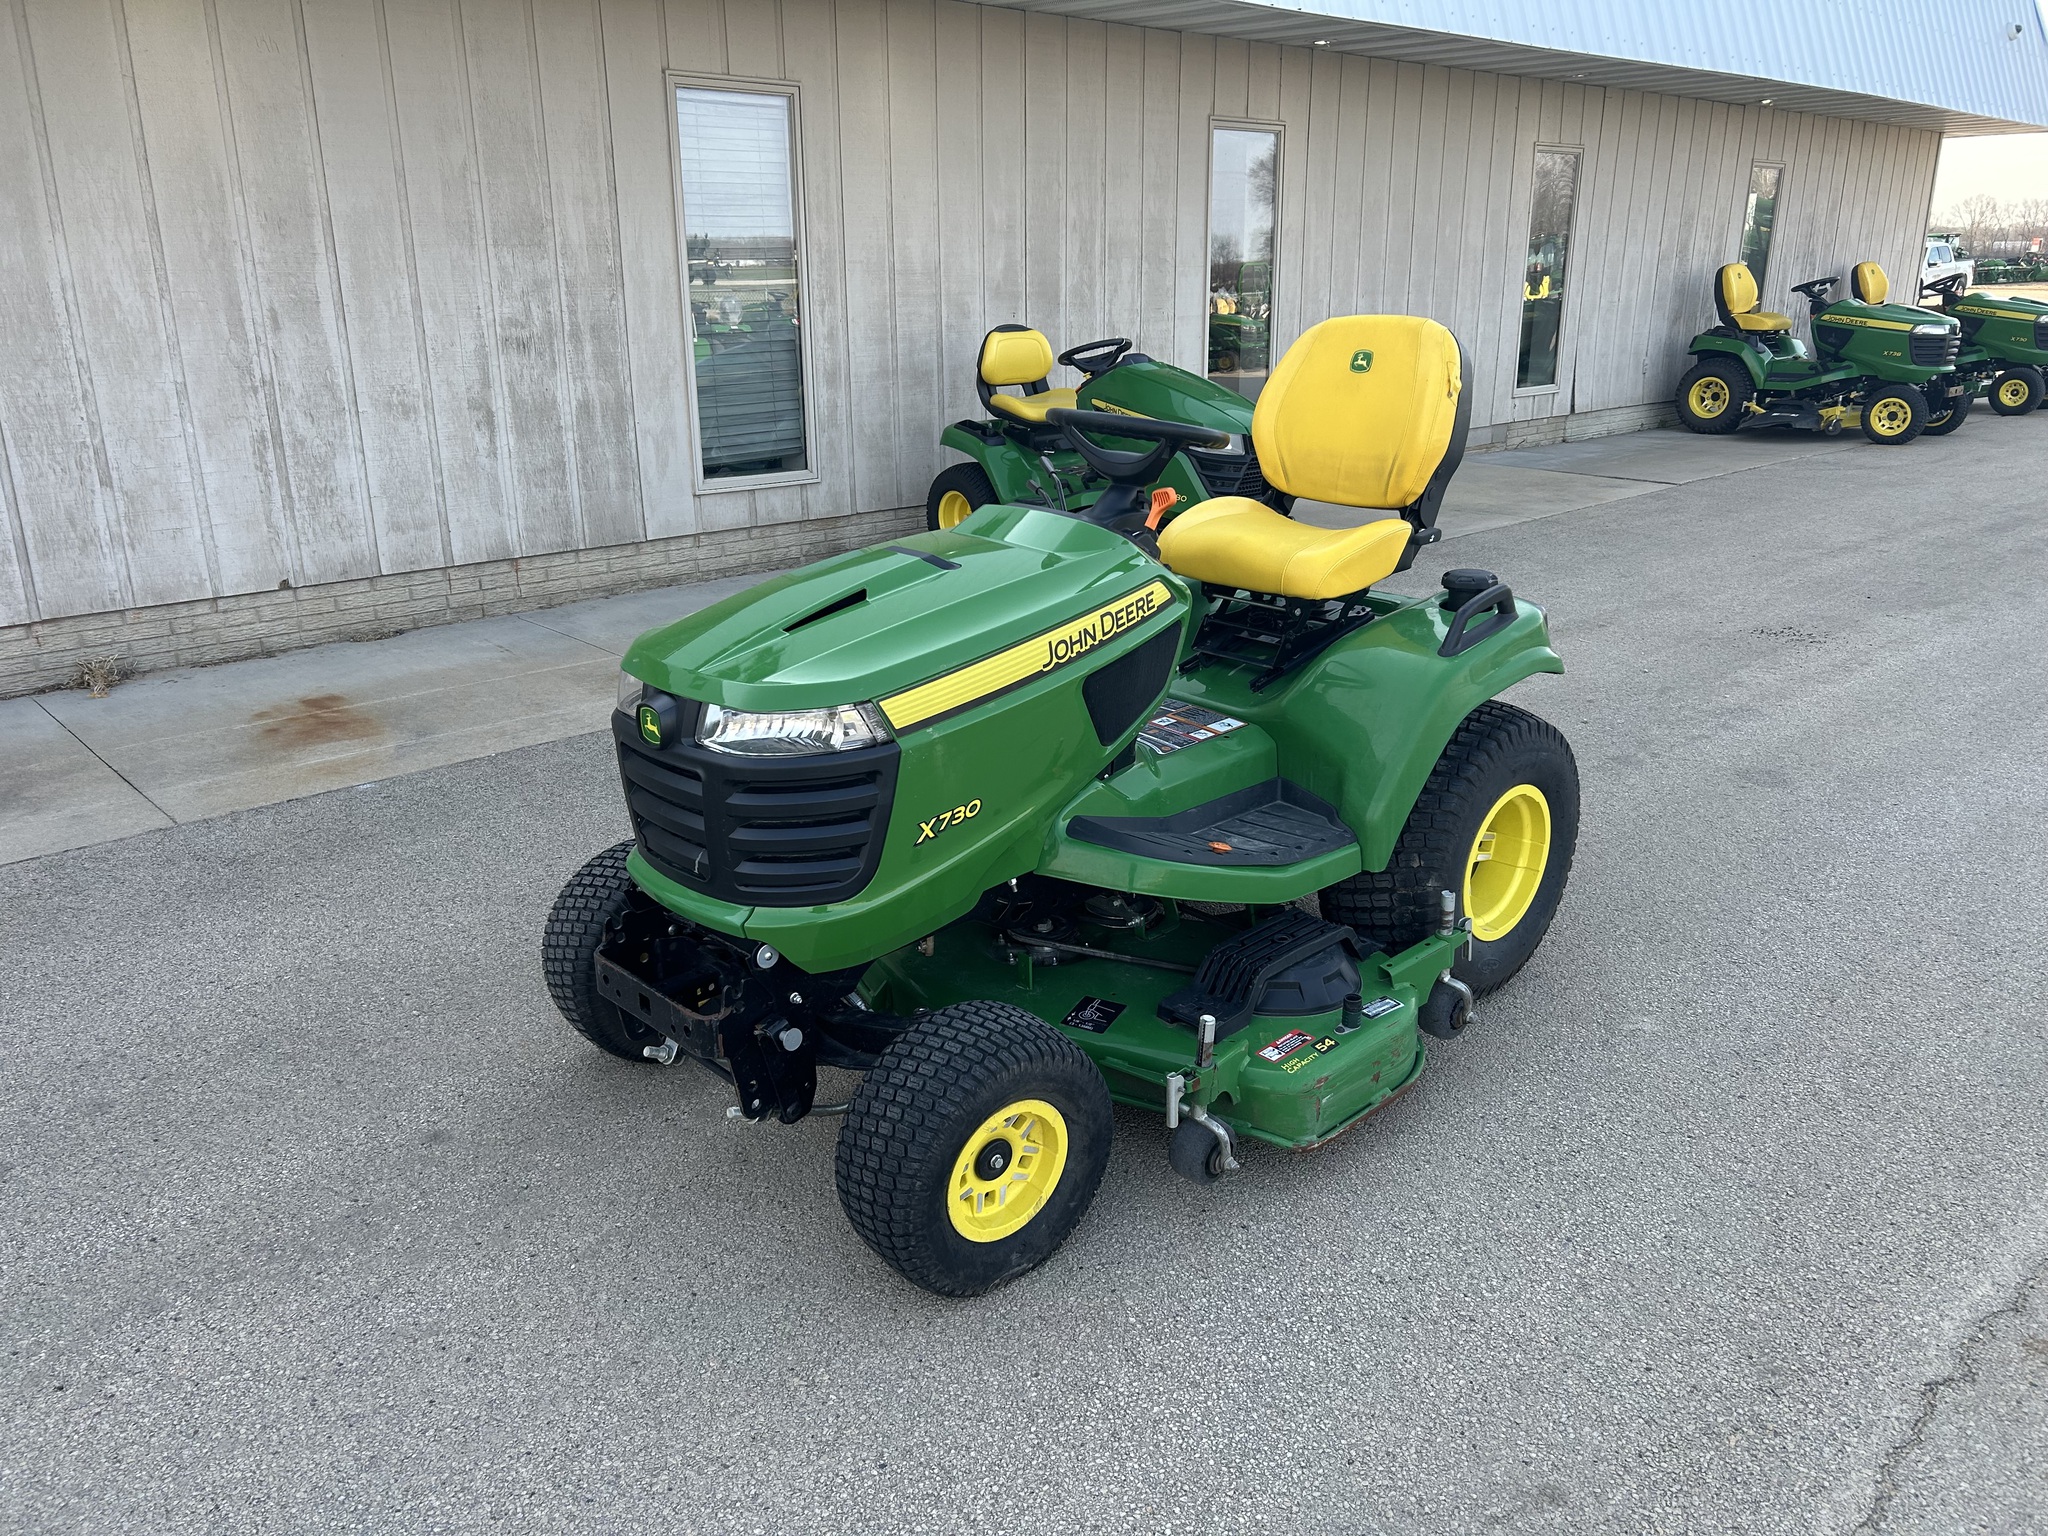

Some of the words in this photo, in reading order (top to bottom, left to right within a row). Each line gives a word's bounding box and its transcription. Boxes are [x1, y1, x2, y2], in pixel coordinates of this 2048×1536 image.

[1961, 306, 1976, 314] JOHN
[1977, 308, 1997, 316] DEERE
[1828, 315, 1845, 323] JOHN
[1846, 317, 1868, 326] DEERE
[1042, 623, 1097, 670] JOHN
[1100, 590, 1156, 638] DEERE
[913, 798, 982, 847] X730
[1315, 1038, 1336, 1053] 54
[1281, 1057, 1300, 1071] HIGH
[1287, 1051, 1319, 1074] CAPACITY
